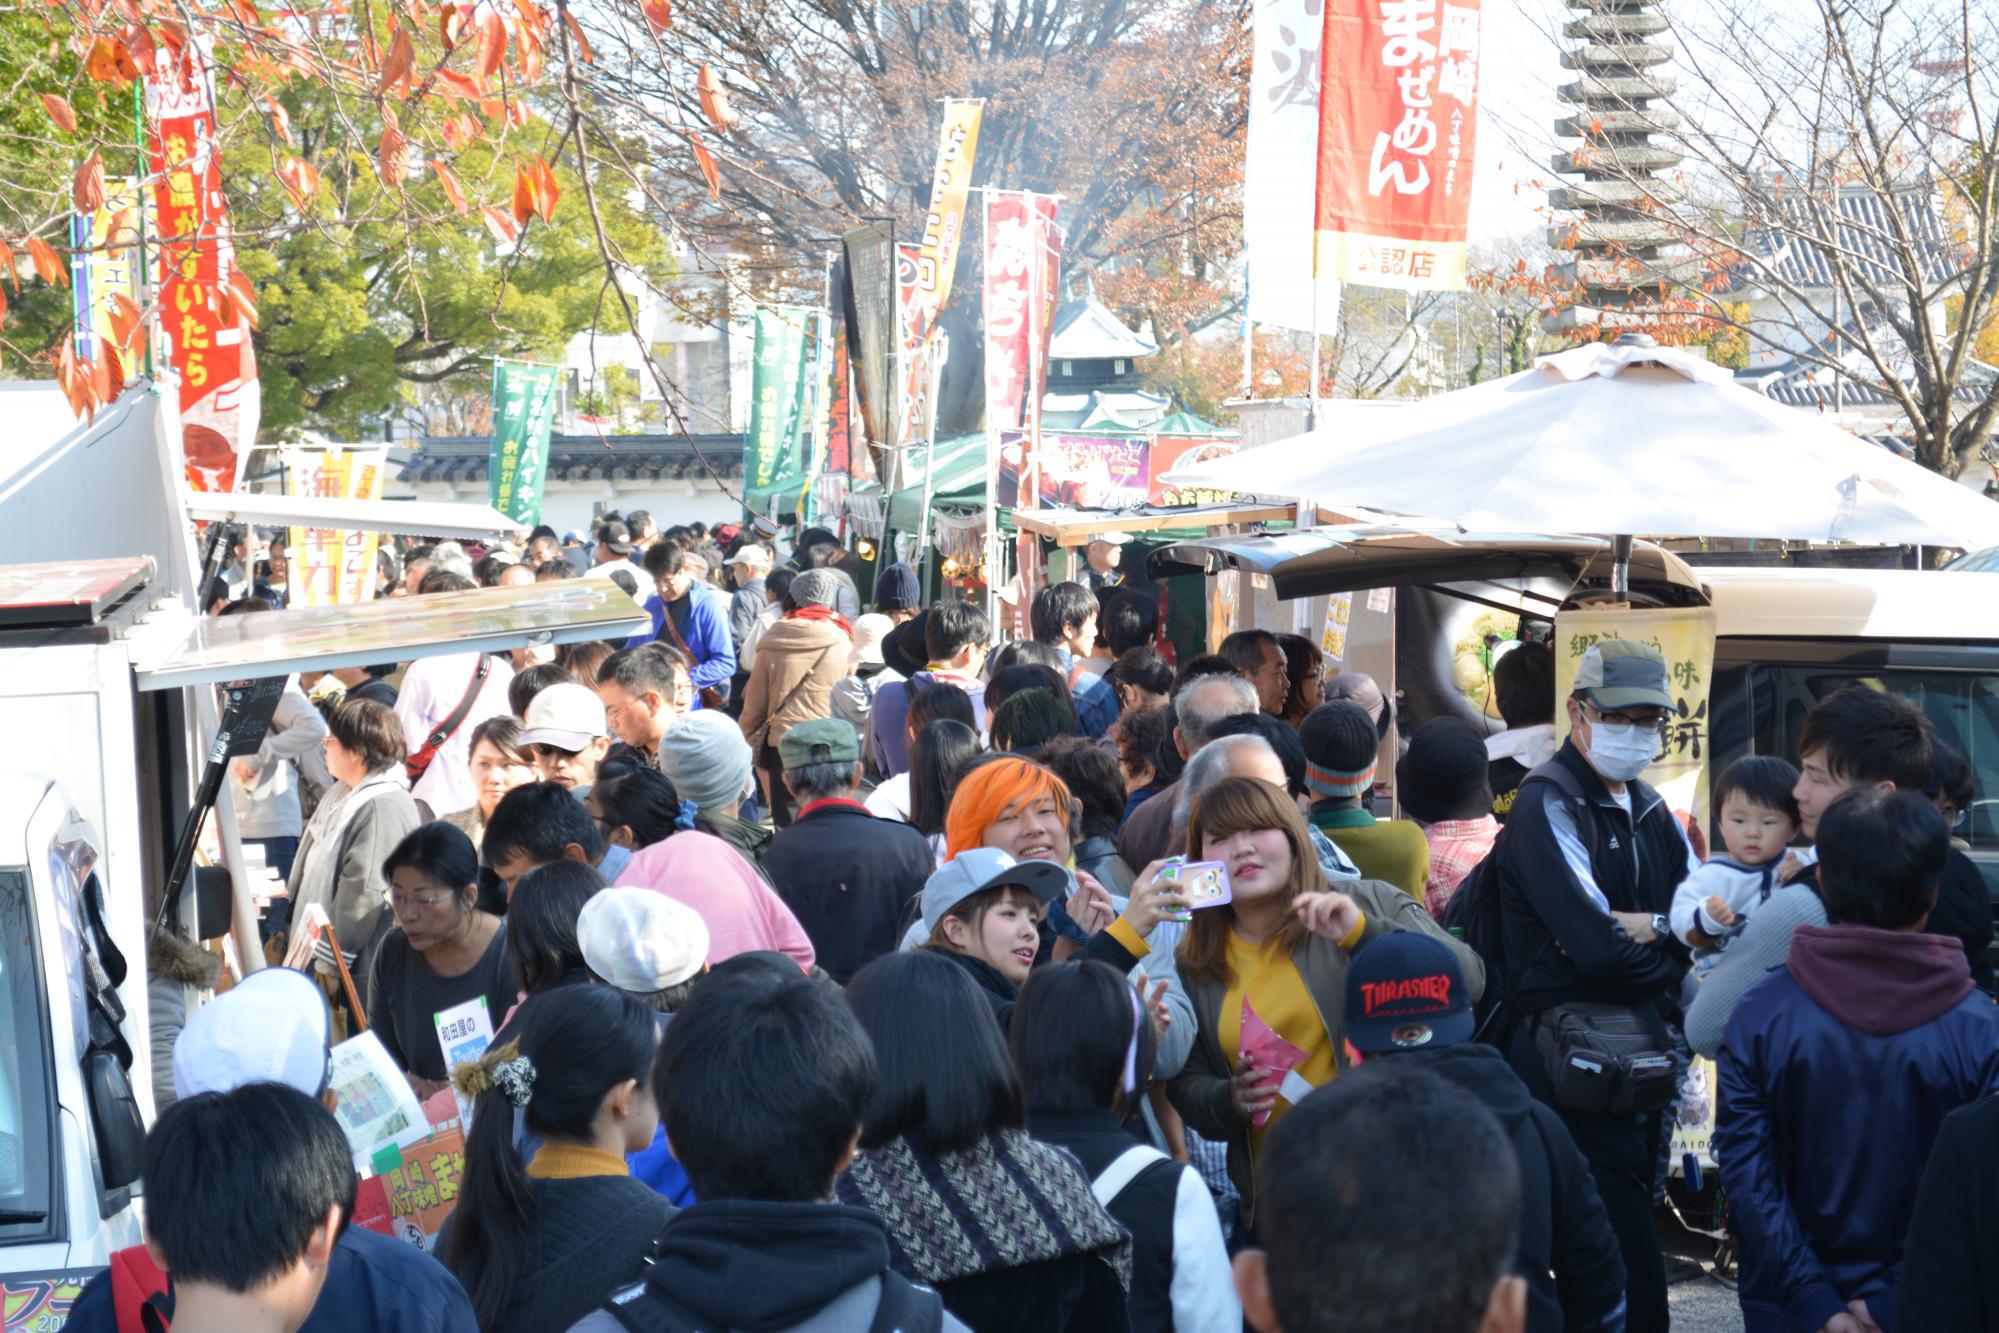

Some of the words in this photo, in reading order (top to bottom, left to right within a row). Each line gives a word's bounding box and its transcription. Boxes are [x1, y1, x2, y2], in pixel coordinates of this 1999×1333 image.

[1438, 2, 1477, 107] 岡崎
[1368, 0, 1437, 196] まぜめん
[1358, 248, 1436, 278] 公認店
[1361, 975, 1451, 1015] THRASHER
[441, 1017, 476, 1043] 和田屋の
